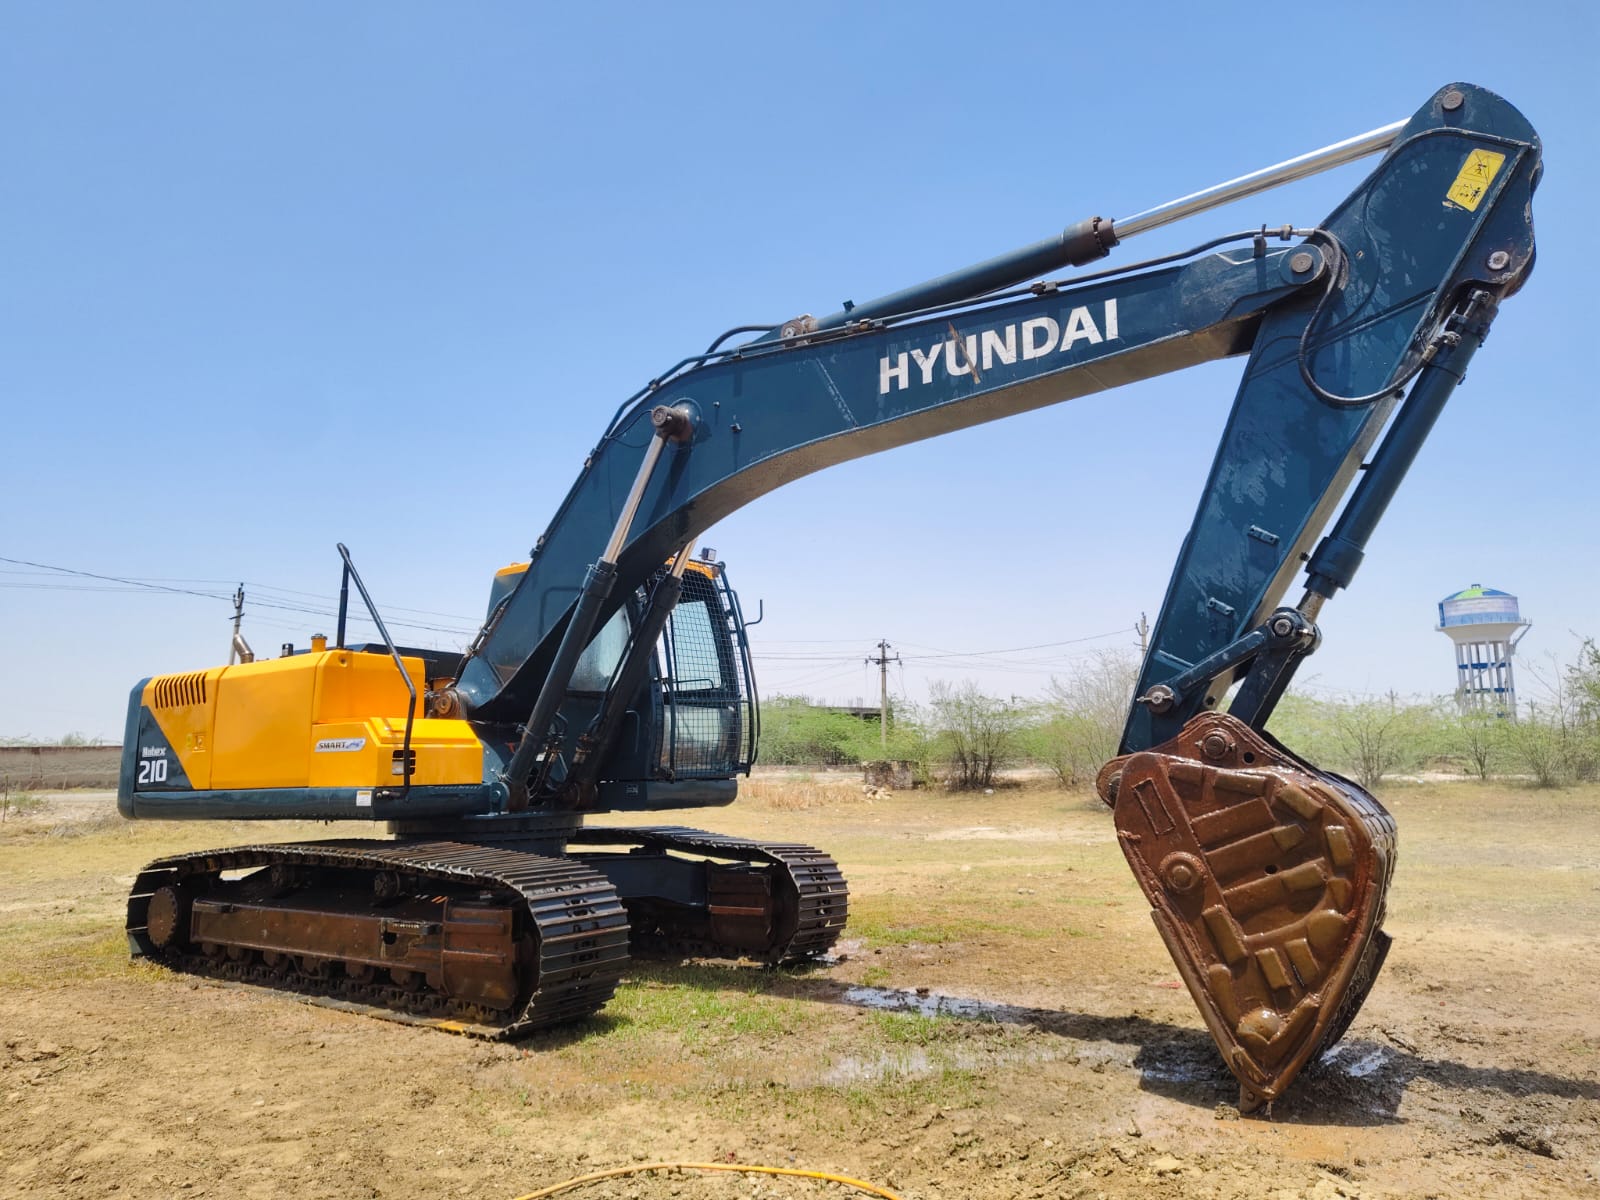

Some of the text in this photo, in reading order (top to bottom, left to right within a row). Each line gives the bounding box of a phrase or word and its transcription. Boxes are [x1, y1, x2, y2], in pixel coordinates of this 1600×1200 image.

[879, 297, 1119, 395] HYUNDAI
[318, 741, 347, 750] SMART
[138, 759, 168, 784] 210
